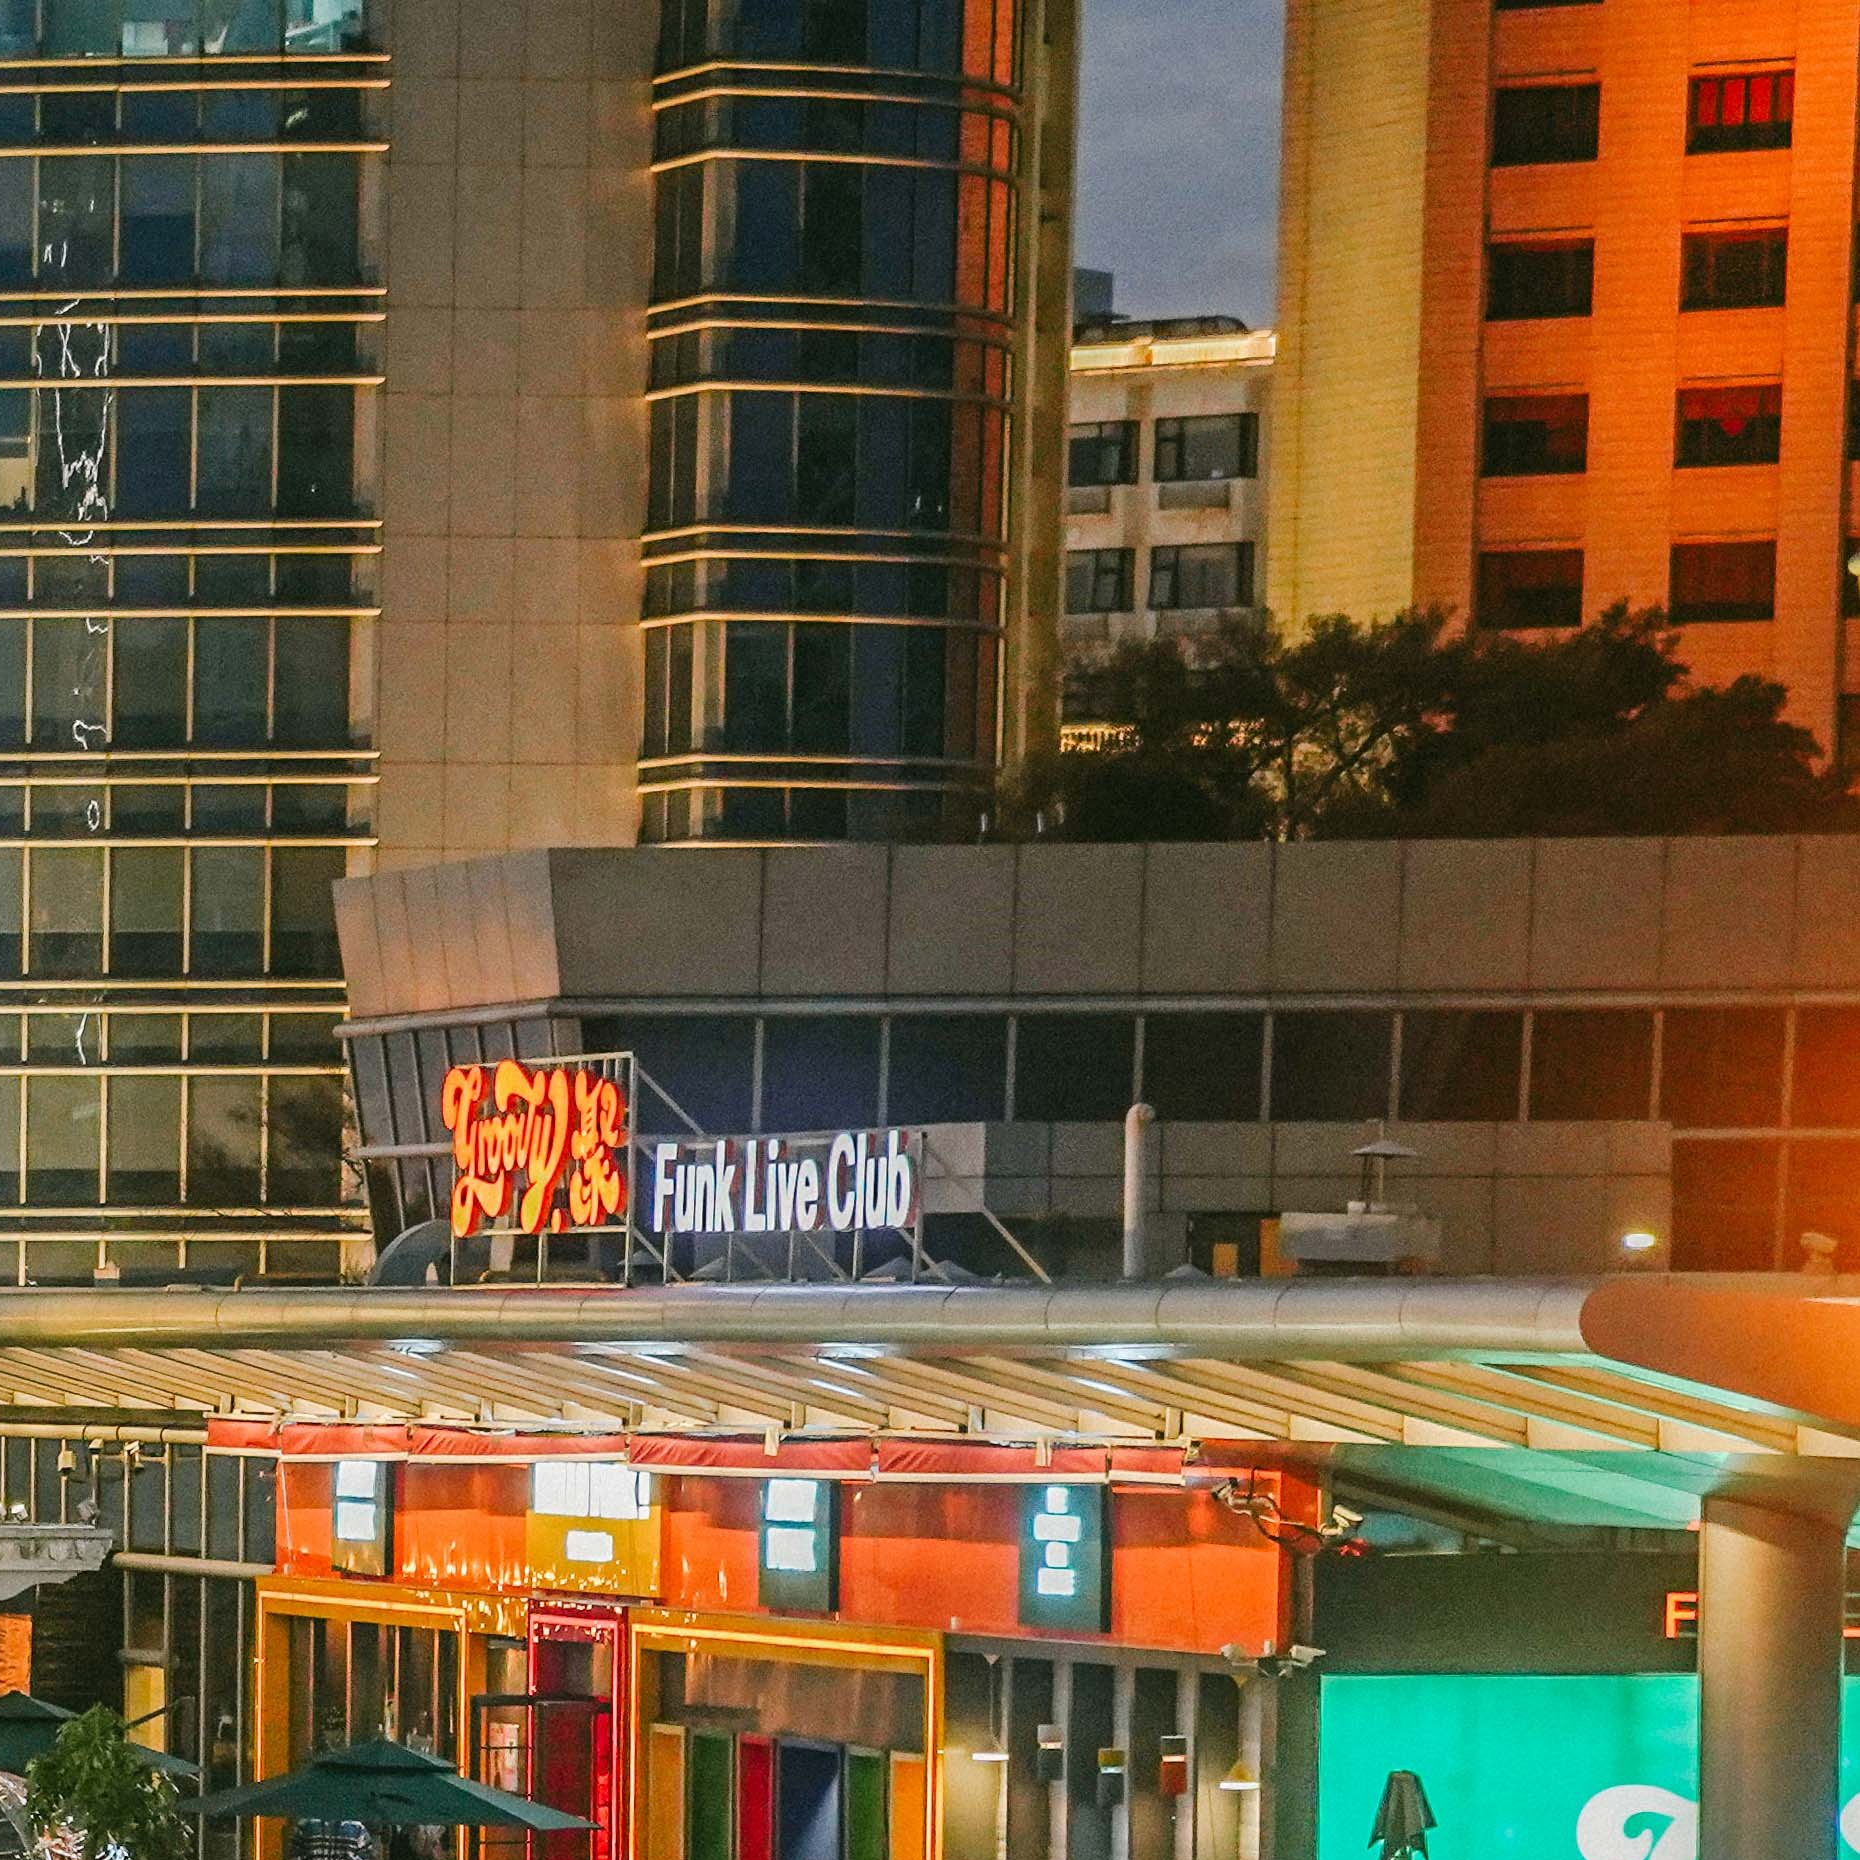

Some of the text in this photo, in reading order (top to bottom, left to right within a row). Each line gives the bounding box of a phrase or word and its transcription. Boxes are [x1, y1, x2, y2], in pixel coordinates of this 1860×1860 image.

[653, 1130, 911, 1232] Funk Live Club
